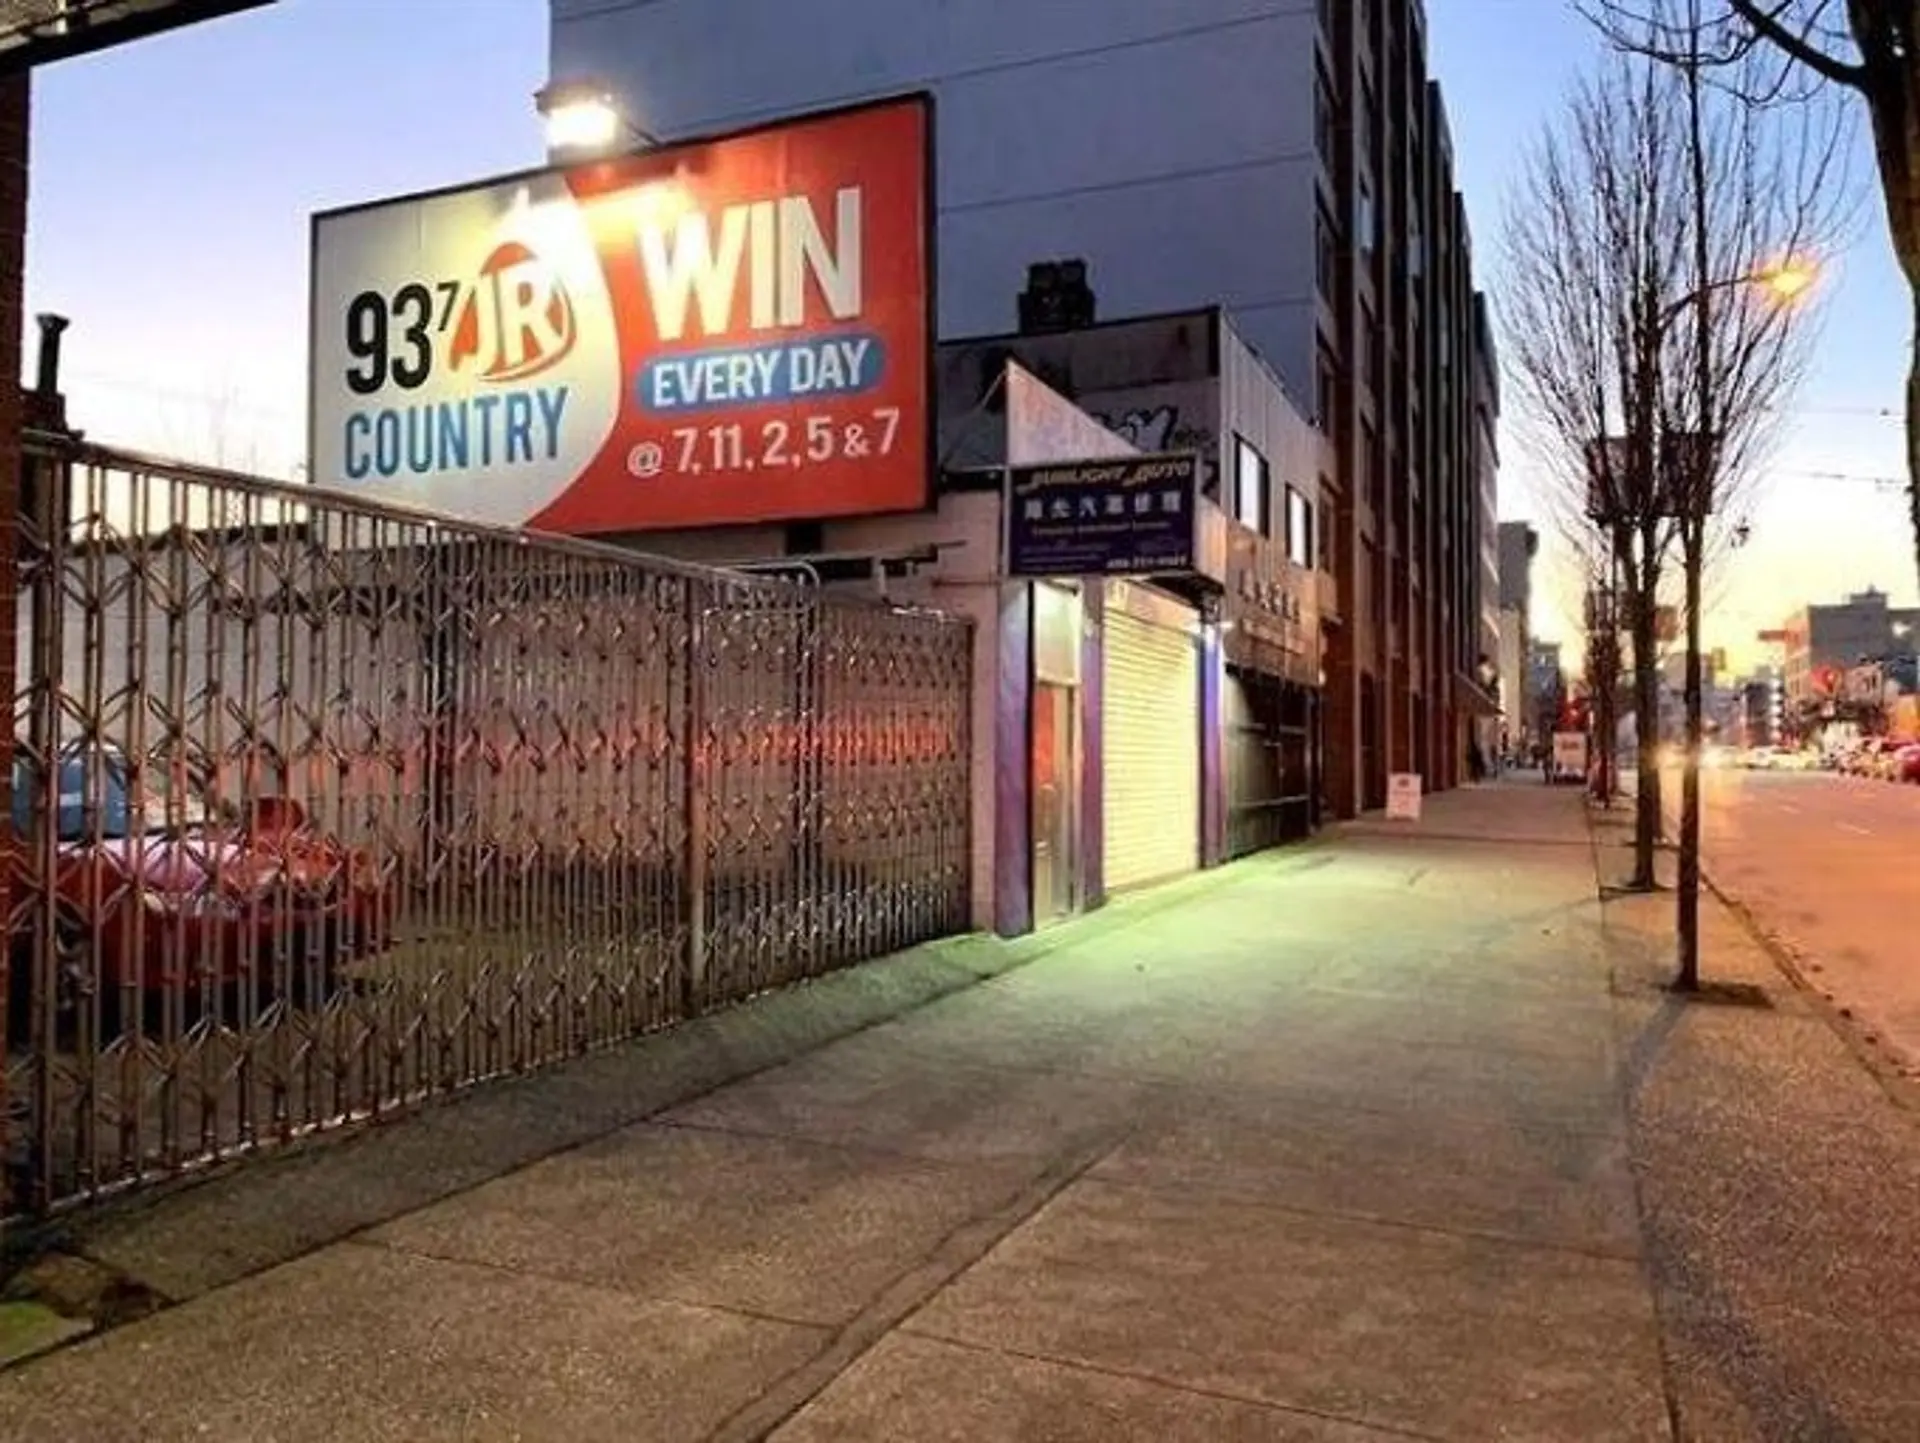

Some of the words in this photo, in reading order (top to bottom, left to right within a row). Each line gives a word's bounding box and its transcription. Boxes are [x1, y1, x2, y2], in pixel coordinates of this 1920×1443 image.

[636, 186, 861, 342] WIN
[653, 350, 781, 408] EVERY
[789, 338, 870, 393] DAY
[345, 386, 568, 480] COUNTRY
[627, 442, 664, 478] @
[843, 423, 870, 457] &
[873, 406, 900, 455] 7
